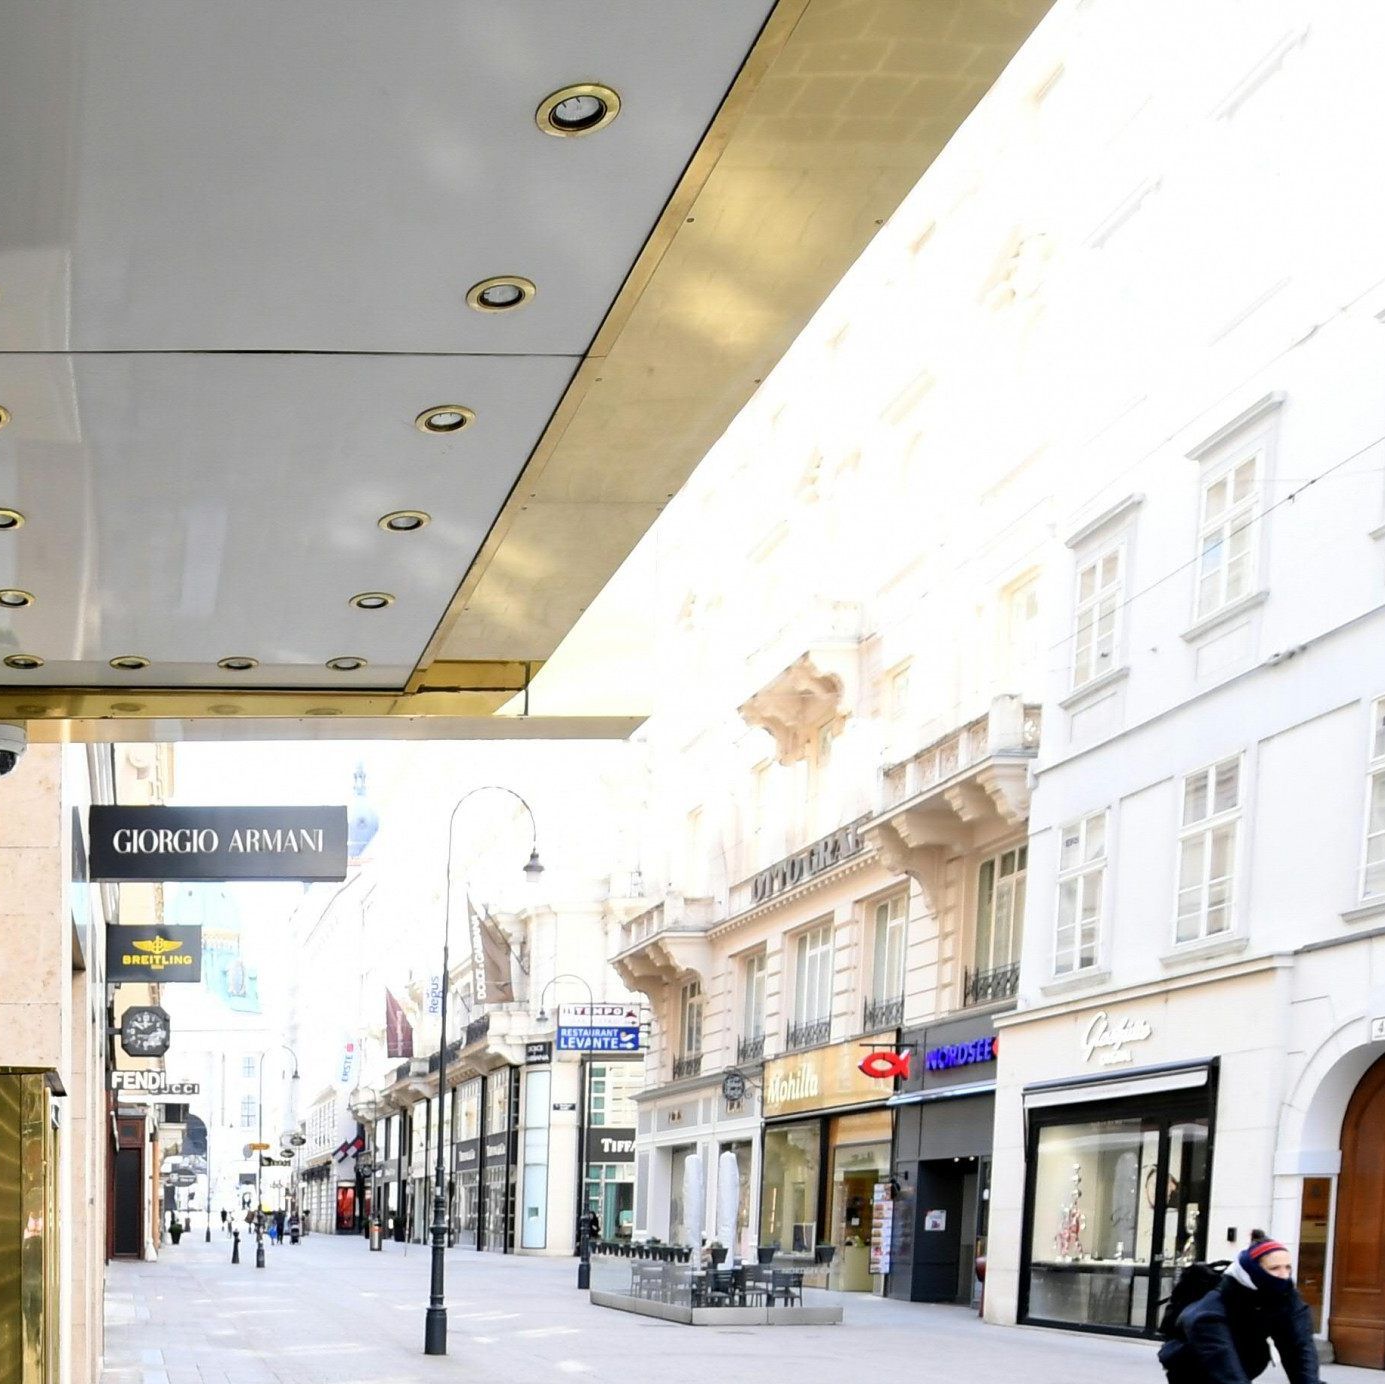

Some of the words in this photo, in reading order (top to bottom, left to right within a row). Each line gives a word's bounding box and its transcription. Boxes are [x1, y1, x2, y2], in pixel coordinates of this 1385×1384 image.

[113, 828, 219, 854] GIORGIO
[228, 828, 324, 853] ARMANI
[122, 954, 193, 965] BREITLING
[427, 975, 444, 1014] Regus
[560, 1028, 619, 1037] RESTAURANT
[560, 1037, 619, 1049] LEVANTE
[925, 1036, 993, 1072] NORDSEE
[111, 1071, 166, 1090] FENDI
